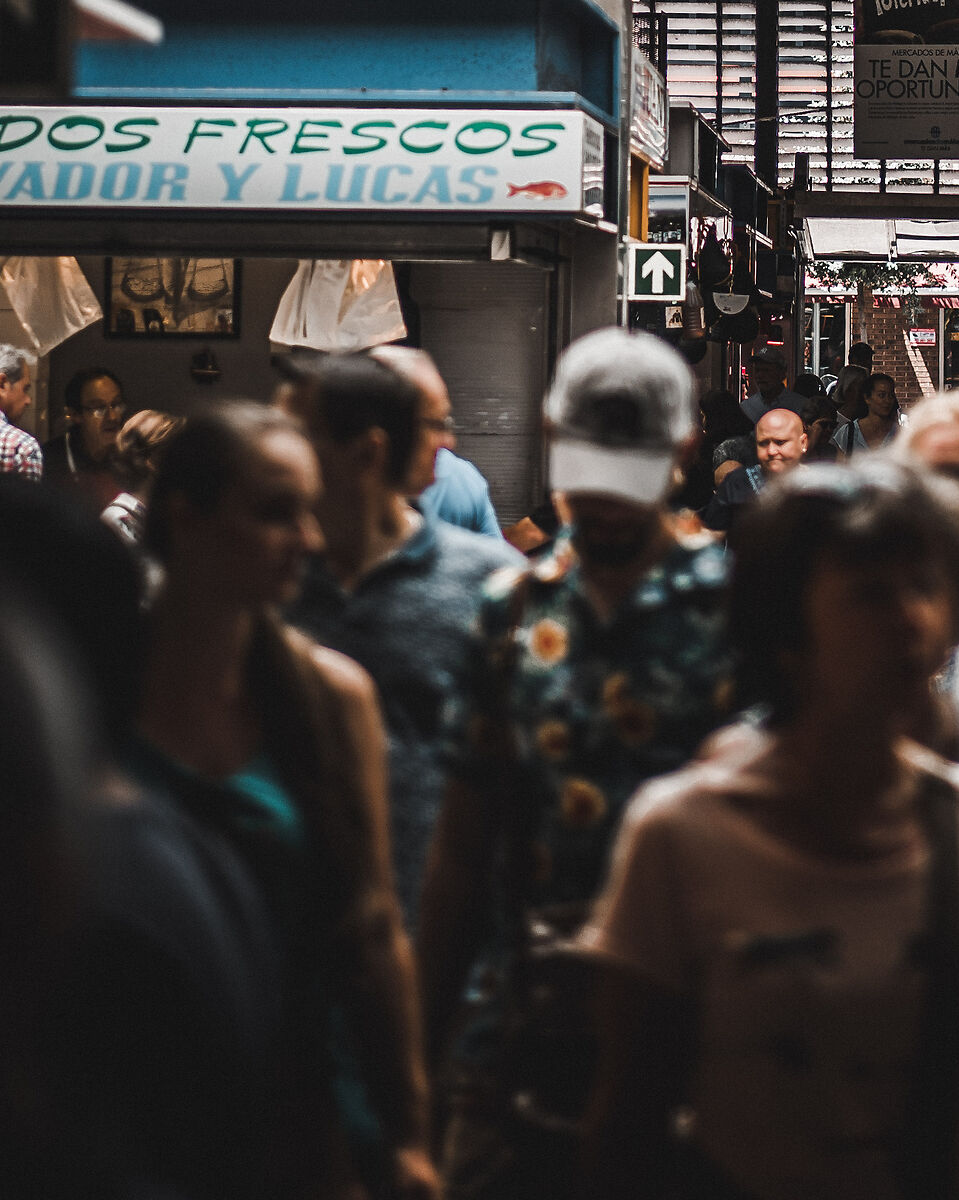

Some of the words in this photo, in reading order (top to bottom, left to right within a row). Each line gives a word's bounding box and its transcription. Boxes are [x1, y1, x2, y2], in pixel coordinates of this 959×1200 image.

[892, 49, 934, 57] MERCADOS
[935, 49, 944, 57] DE
[868, 59, 891, 79] TE
[899, 59, 948, 79] DAN
[0, 114, 160, 152] DOS
[183, 118, 566, 157] FRESCOS
[217, 162, 262, 202] Y
[278, 163, 499, 205] LUCAS
